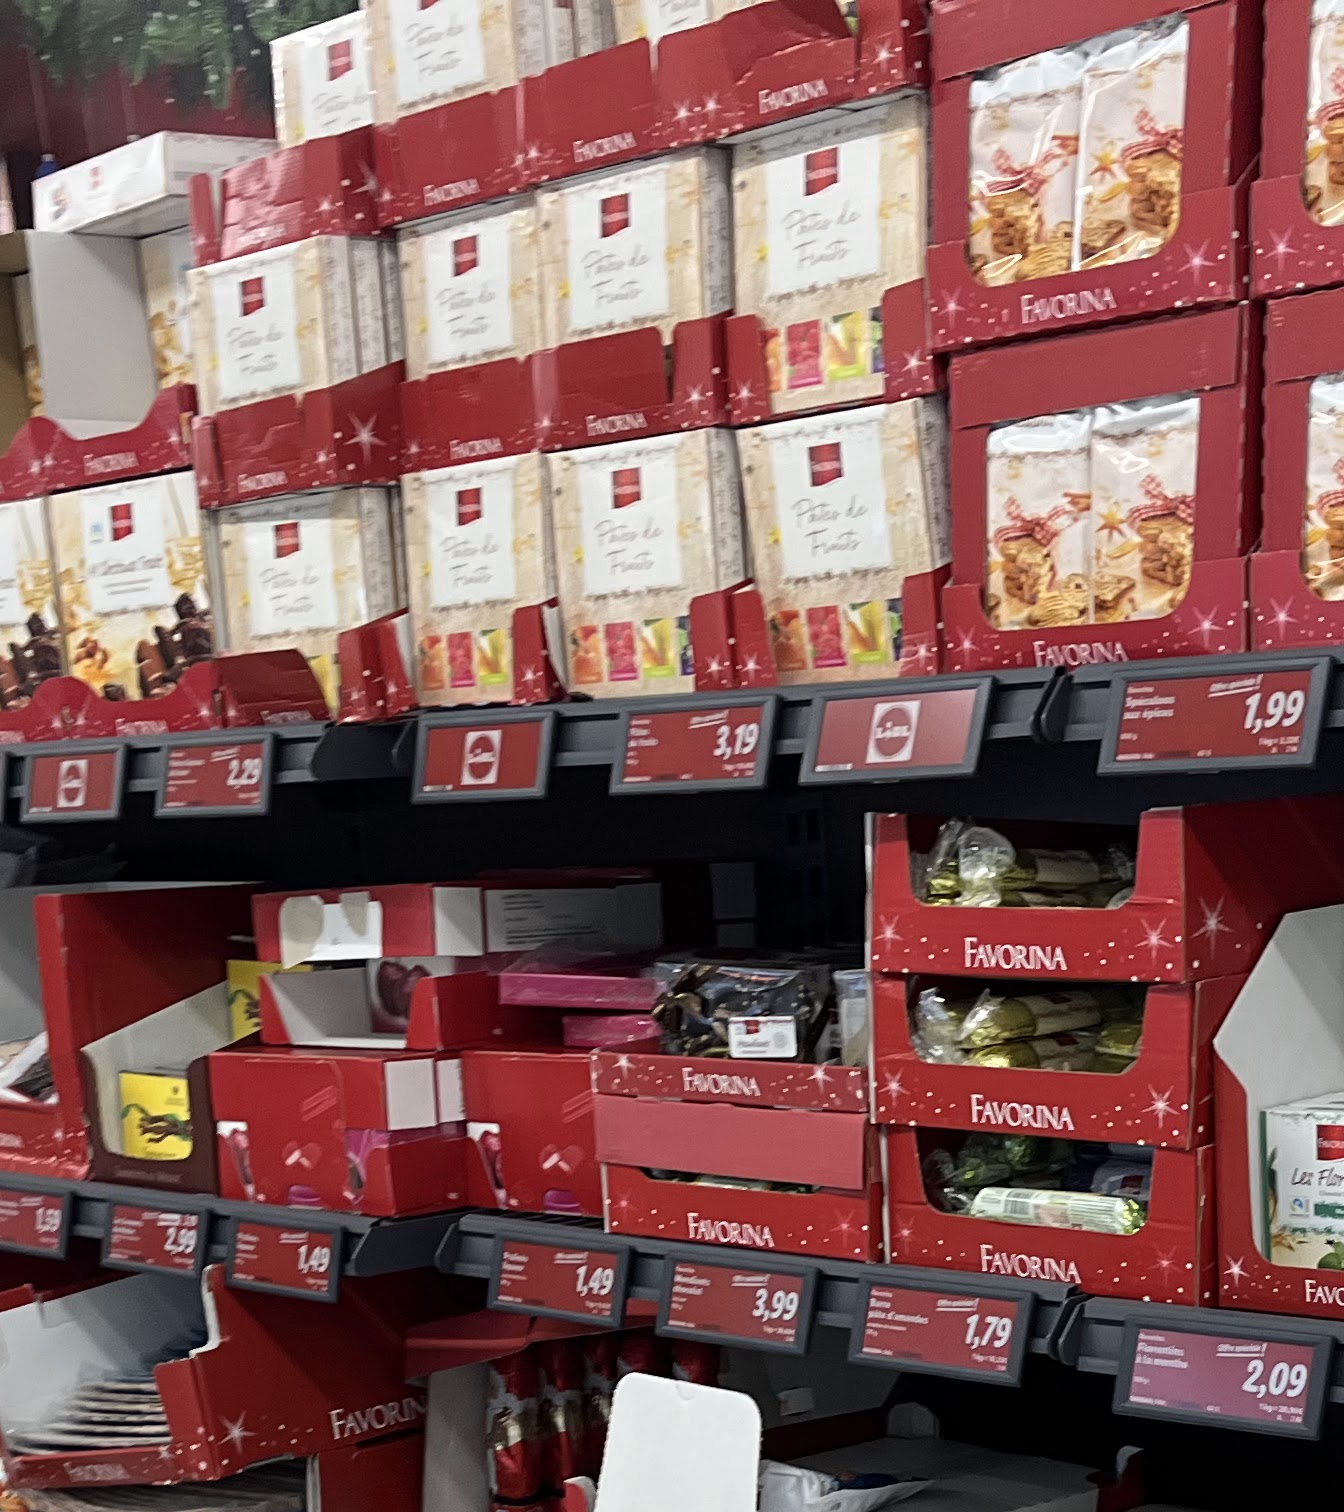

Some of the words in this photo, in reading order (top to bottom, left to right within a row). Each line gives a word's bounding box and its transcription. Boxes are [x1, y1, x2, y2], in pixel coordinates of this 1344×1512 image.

[1020, 286, 1117, 324] FAVORINA
[1244, 690, 1305, 734] 1,99
[713, 723, 760, 759] 3,19
[964, 935, 1068, 971] FAVORINA
[970, 1094, 1075, 1131] FAVORINA
[1291, 1167, 1313, 1188] Les
[687, 1212, 774, 1248] FAVORINA
[575, 1266, 615, 1297] 1,49
[980, 1244, 1082, 1284] FAVORINA
[753, 1289, 799, 1321] 3,99
[965, 1314, 1013, 1350] 1,79
[1242, 1359, 1307, 1398] 2,09
